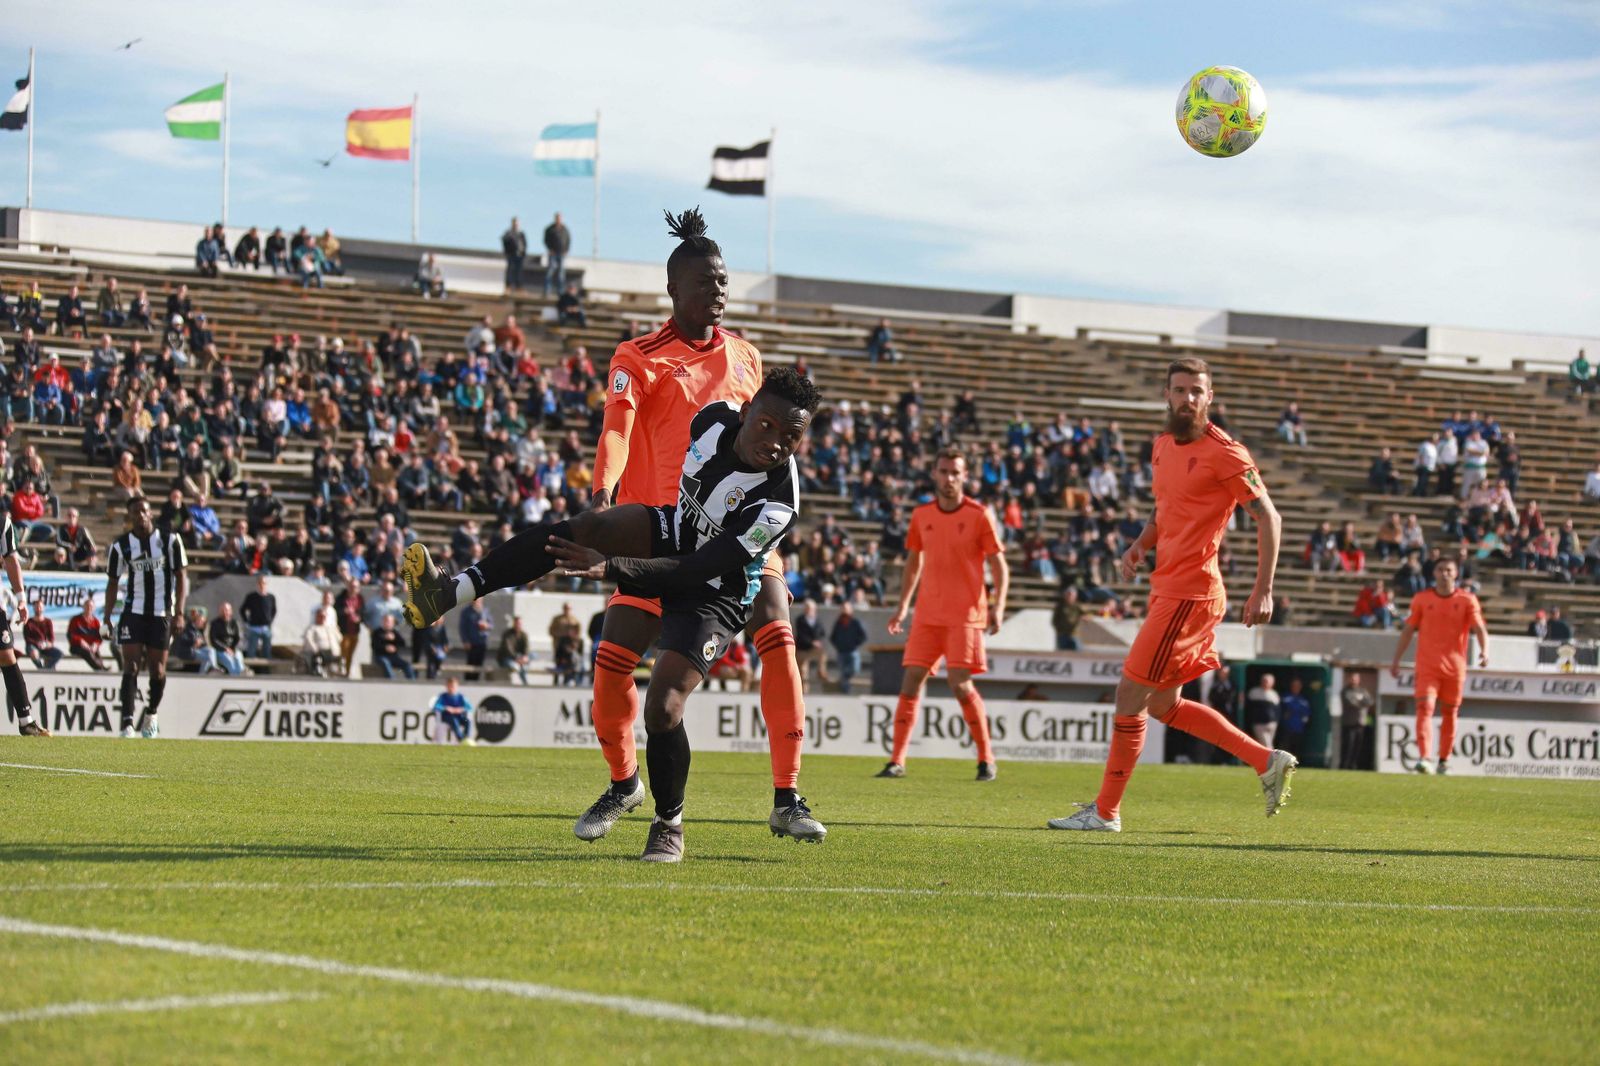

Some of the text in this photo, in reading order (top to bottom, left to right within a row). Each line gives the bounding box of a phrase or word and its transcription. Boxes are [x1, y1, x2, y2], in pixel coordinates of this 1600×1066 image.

[1014, 658, 1074, 676] LEGEA
[266, 691, 344, 706] INDUSTRIAS
[1469, 677, 1597, 697] LEGEA LEGEA
[263, 708, 343, 739] LACSE
[718, 704, 741, 738] El
[1020, 709, 1113, 743] Carril
[1438, 724, 1514, 766] ojas
